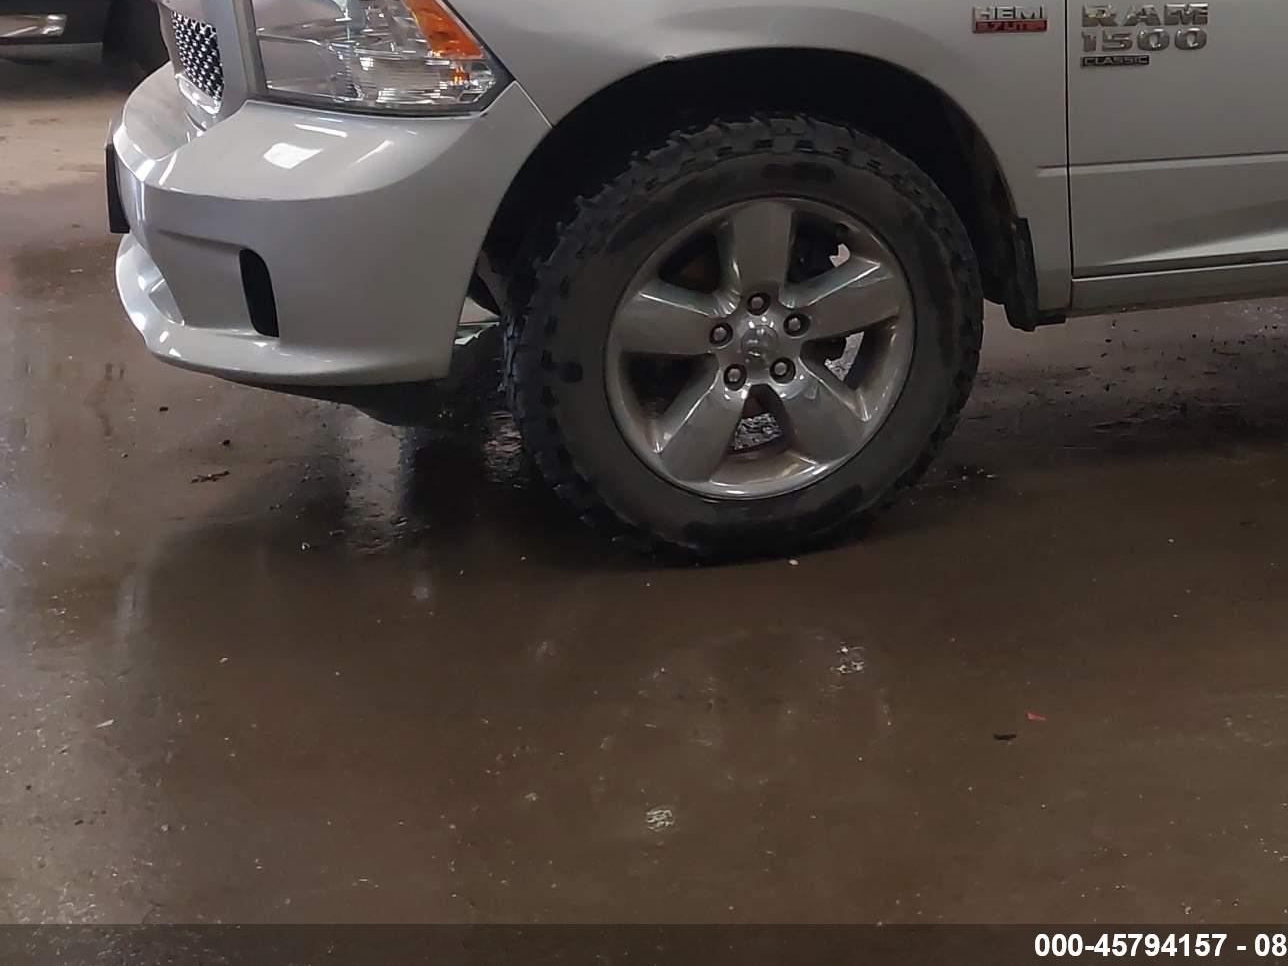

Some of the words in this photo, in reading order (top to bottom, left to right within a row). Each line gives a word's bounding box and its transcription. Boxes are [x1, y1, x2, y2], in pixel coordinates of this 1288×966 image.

[972, 6, 1048, 20] HEMI
[1082, 3, 1208, 27] RAM
[1081, 28, 1208, 52] 1500
[1084, 55, 1148, 66] CLASSIC
